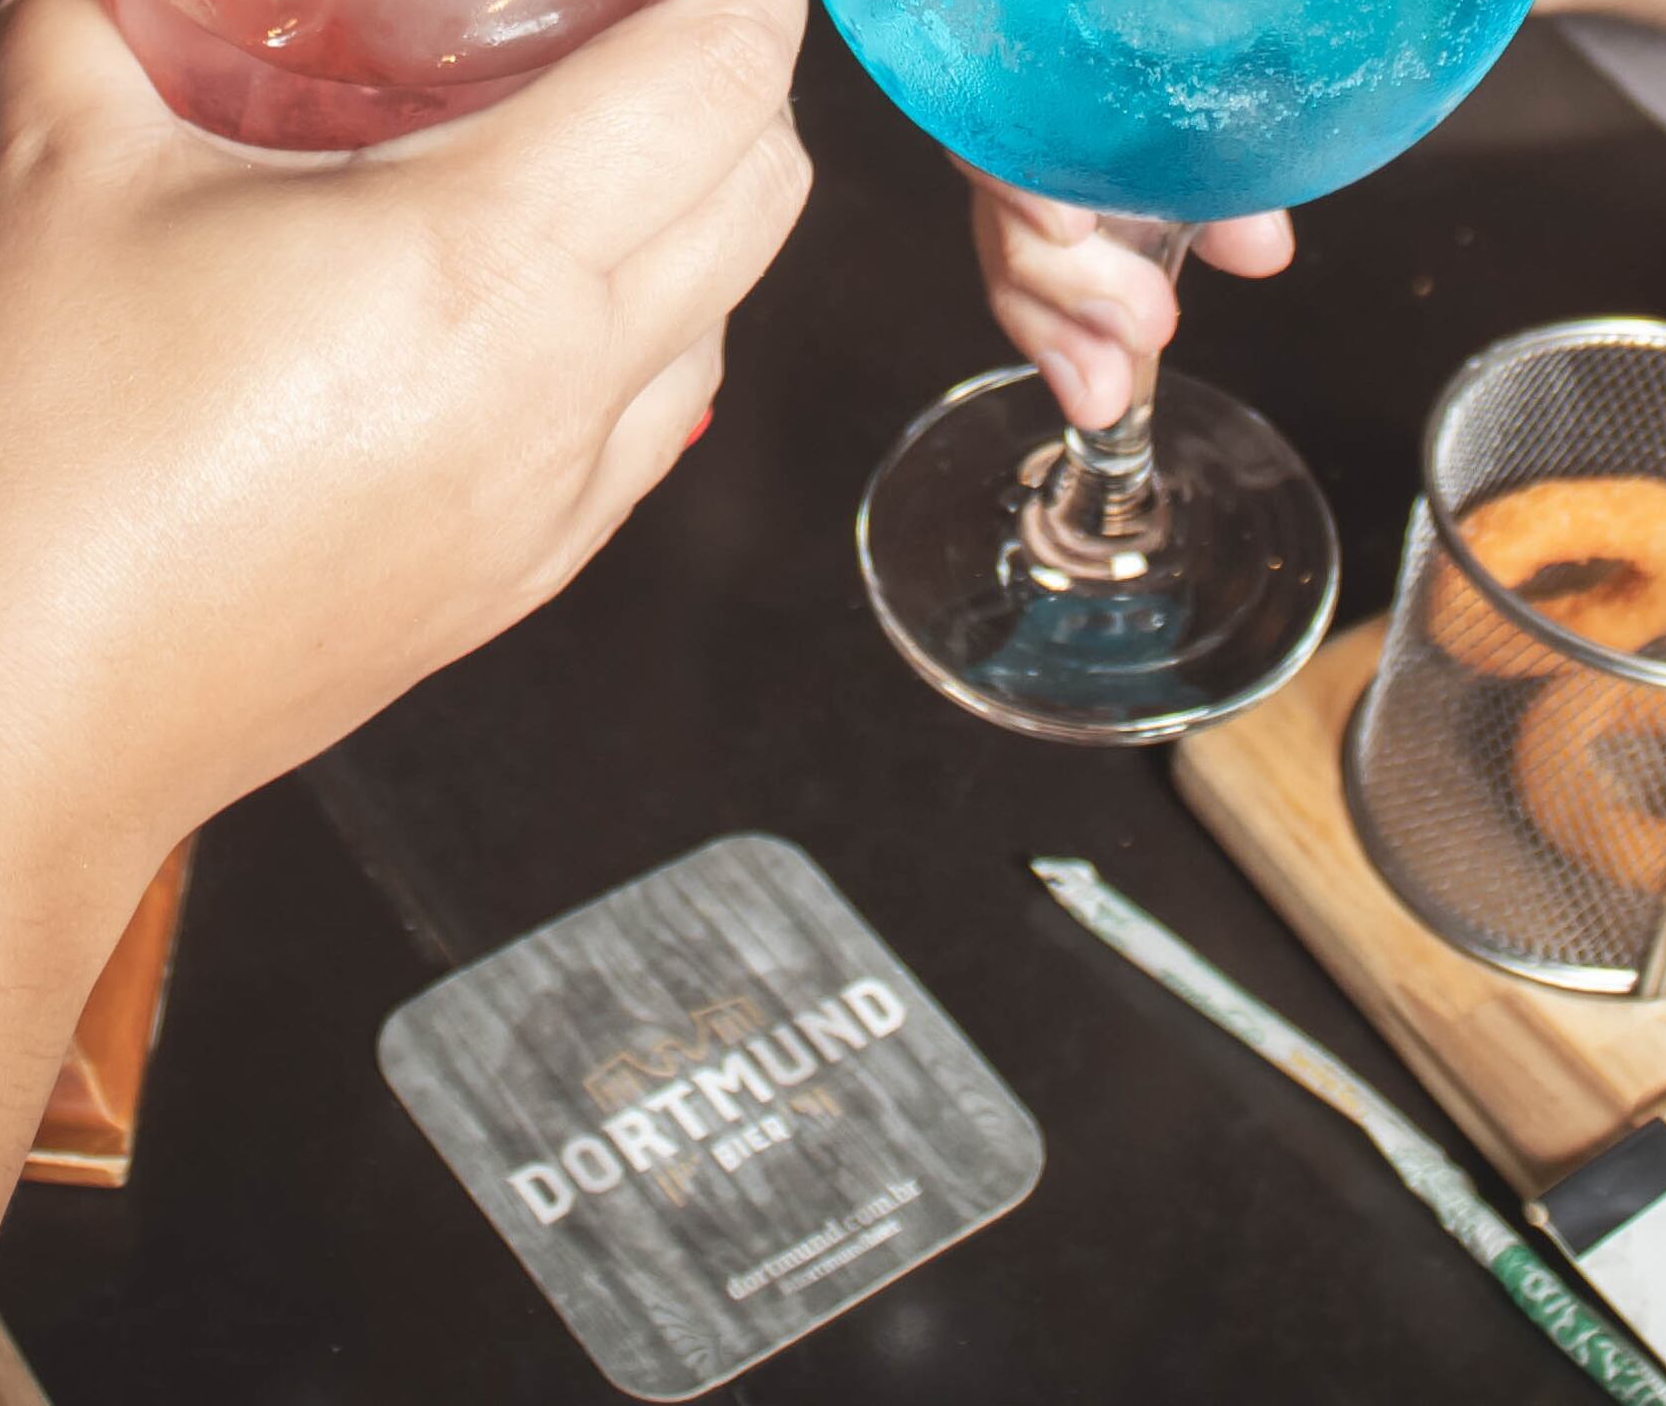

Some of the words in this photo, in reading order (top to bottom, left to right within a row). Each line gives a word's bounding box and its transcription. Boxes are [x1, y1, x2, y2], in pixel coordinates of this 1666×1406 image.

[506, 977, 907, 1226] DORTMUND
[711, 1114, 792, 1174] BIER
[727, 1179, 922, 1300] dortmund.com.br
